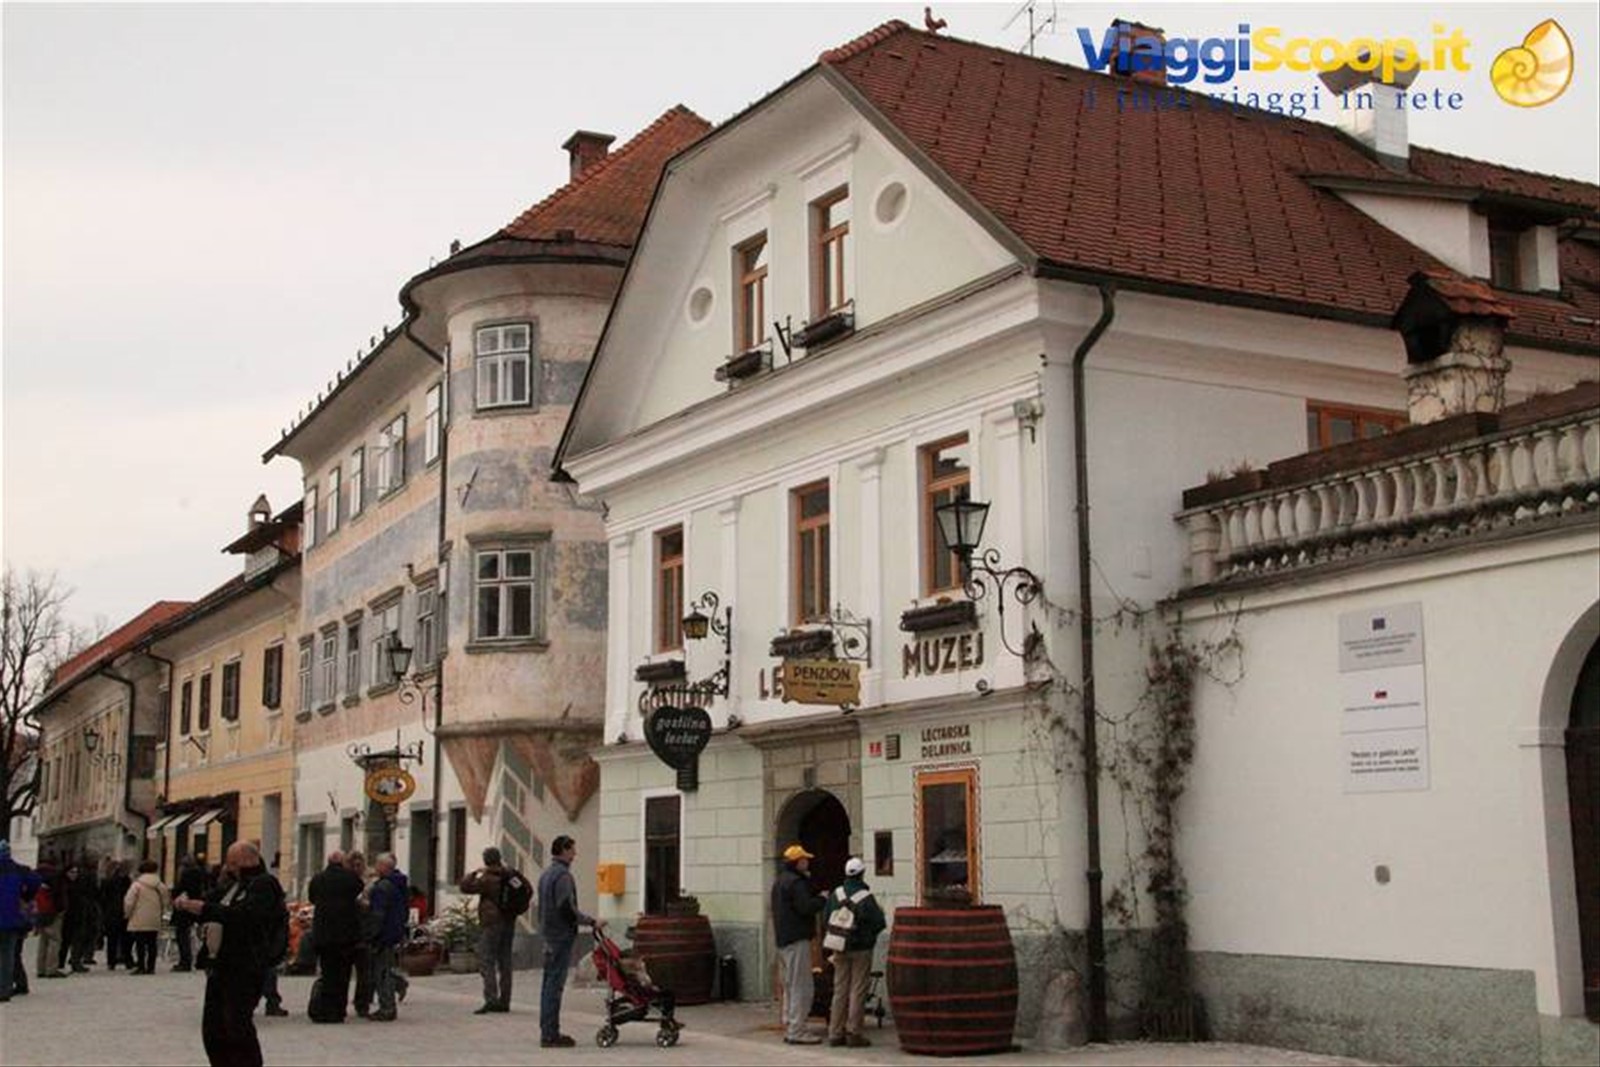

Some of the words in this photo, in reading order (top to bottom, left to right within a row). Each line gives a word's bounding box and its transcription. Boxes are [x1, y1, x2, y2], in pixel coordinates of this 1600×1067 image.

[903, 632, 984, 679] MUZEJ
[794, 666, 851, 681] PENZION
[921, 725, 970, 742] LECTARSKA
[921, 741, 971, 758] DELAVNICA
